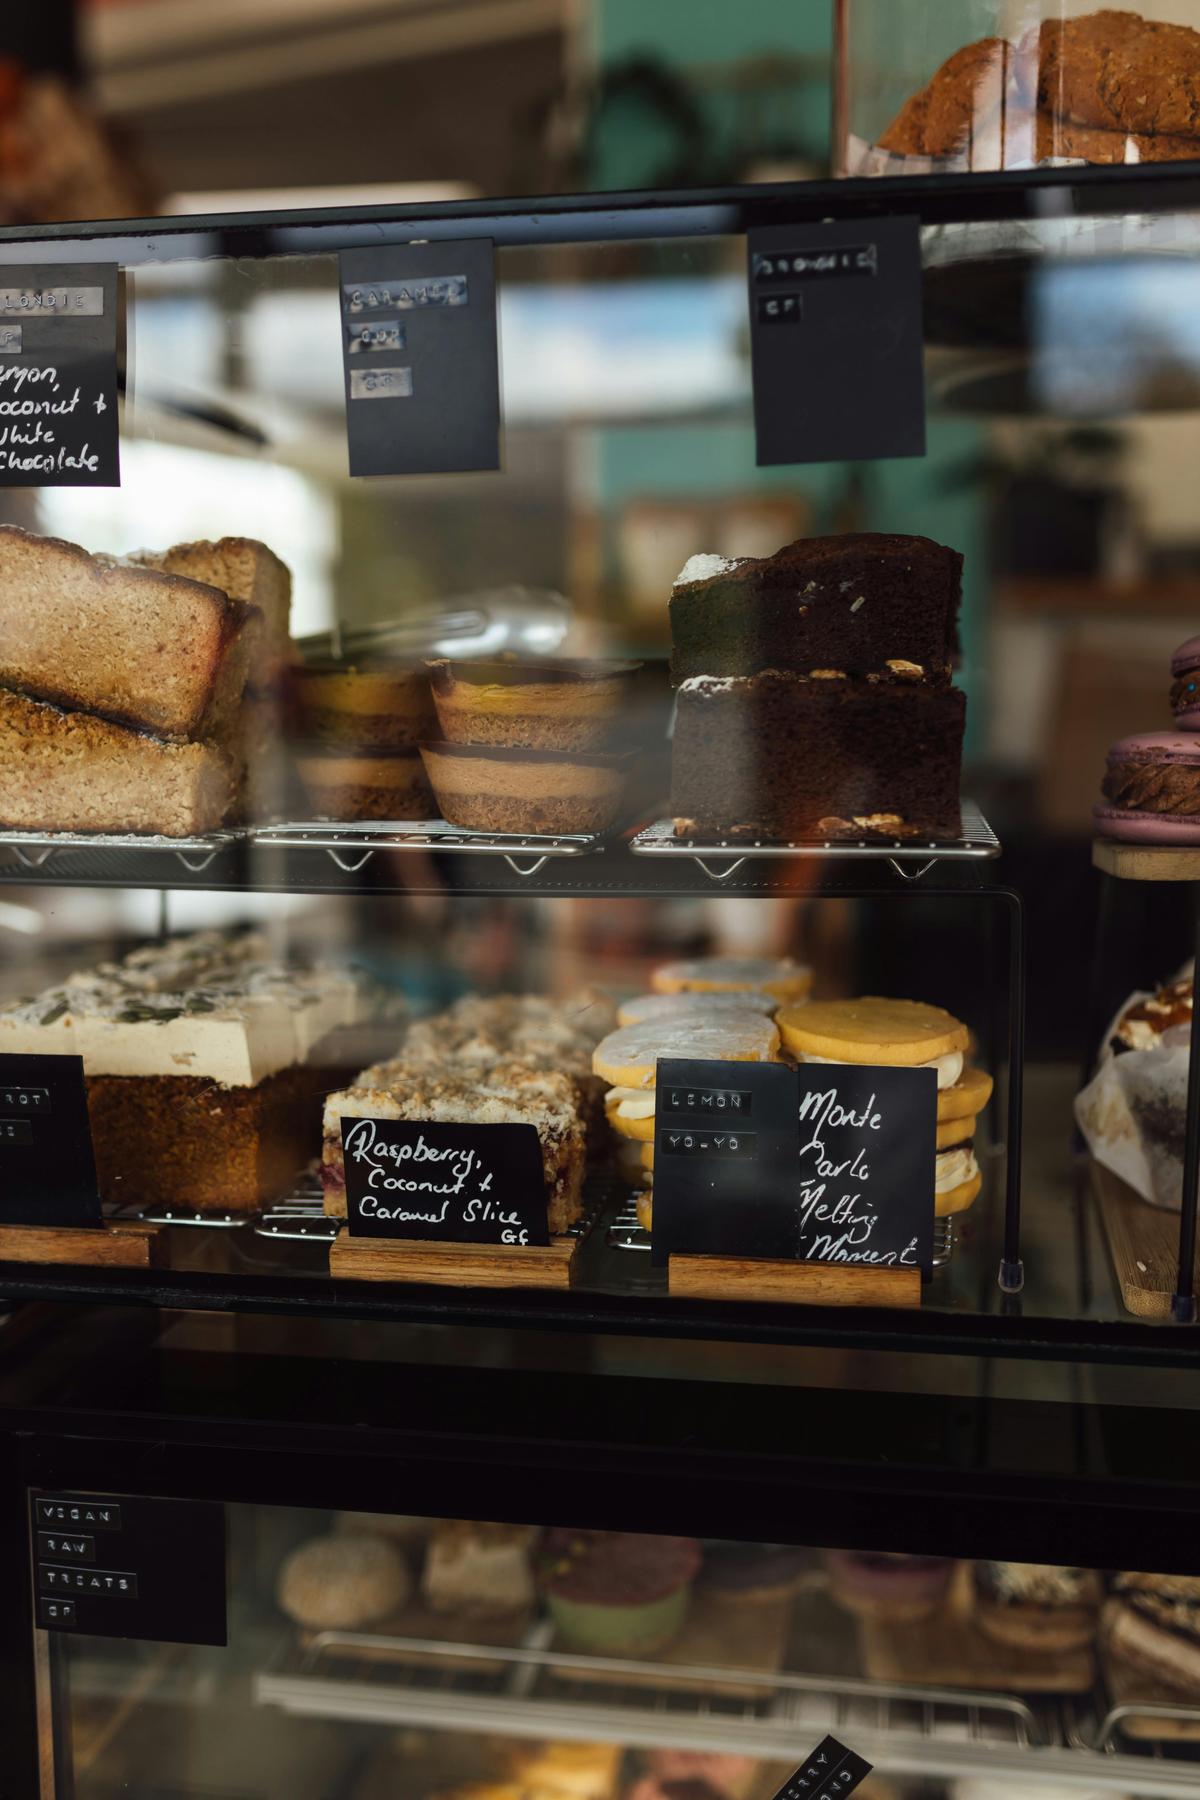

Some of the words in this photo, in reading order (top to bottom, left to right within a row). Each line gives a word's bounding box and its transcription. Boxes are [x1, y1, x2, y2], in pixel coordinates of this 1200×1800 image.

[0, 365, 59, 393] emon,
[671, 1093, 741, 1108] LEMON
[669, 1135, 739, 1150] YO-YO
[367, 1168, 465, 1195] Coconut
[462, 1199, 522, 1226] Slice
[43, 1507, 111, 1522] VEGAN
[47, 1539, 86, 1554] RAW
[48, 1572, 128, 1590] TREATS
[782, 1753, 828, 1800] ERRY
